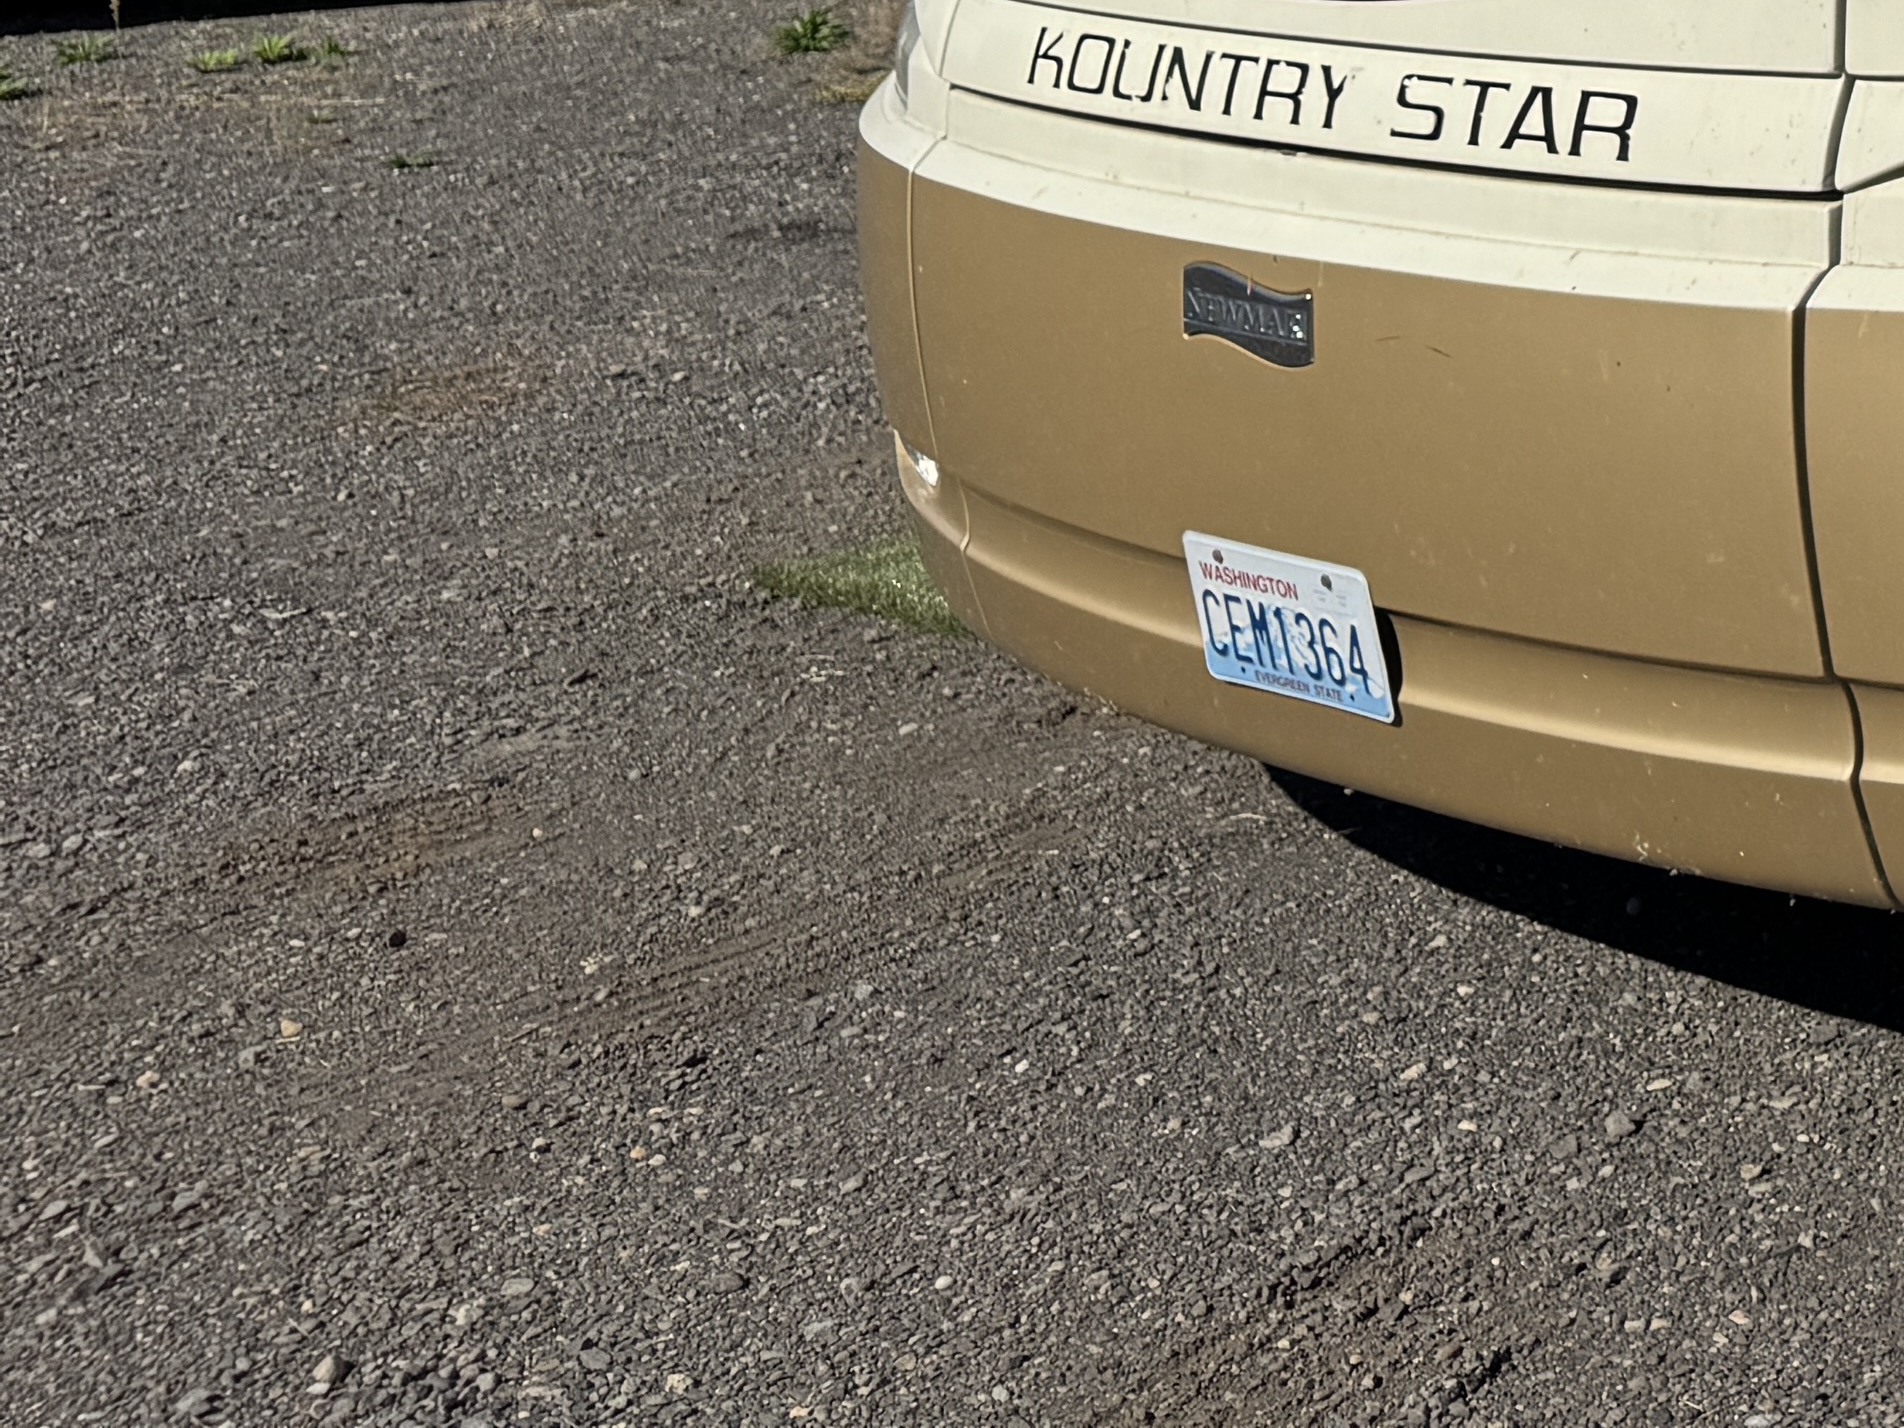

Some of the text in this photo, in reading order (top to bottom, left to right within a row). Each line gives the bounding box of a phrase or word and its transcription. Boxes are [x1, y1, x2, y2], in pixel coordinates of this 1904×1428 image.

[1026, 26, 1640, 162] KOUNTRY STAR
[1198, 560, 1299, 601] WASHINGTON
[1202, 589, 1372, 695] CEM1364
[1255, 670, 1345, 703] EVERGREEN STATE
